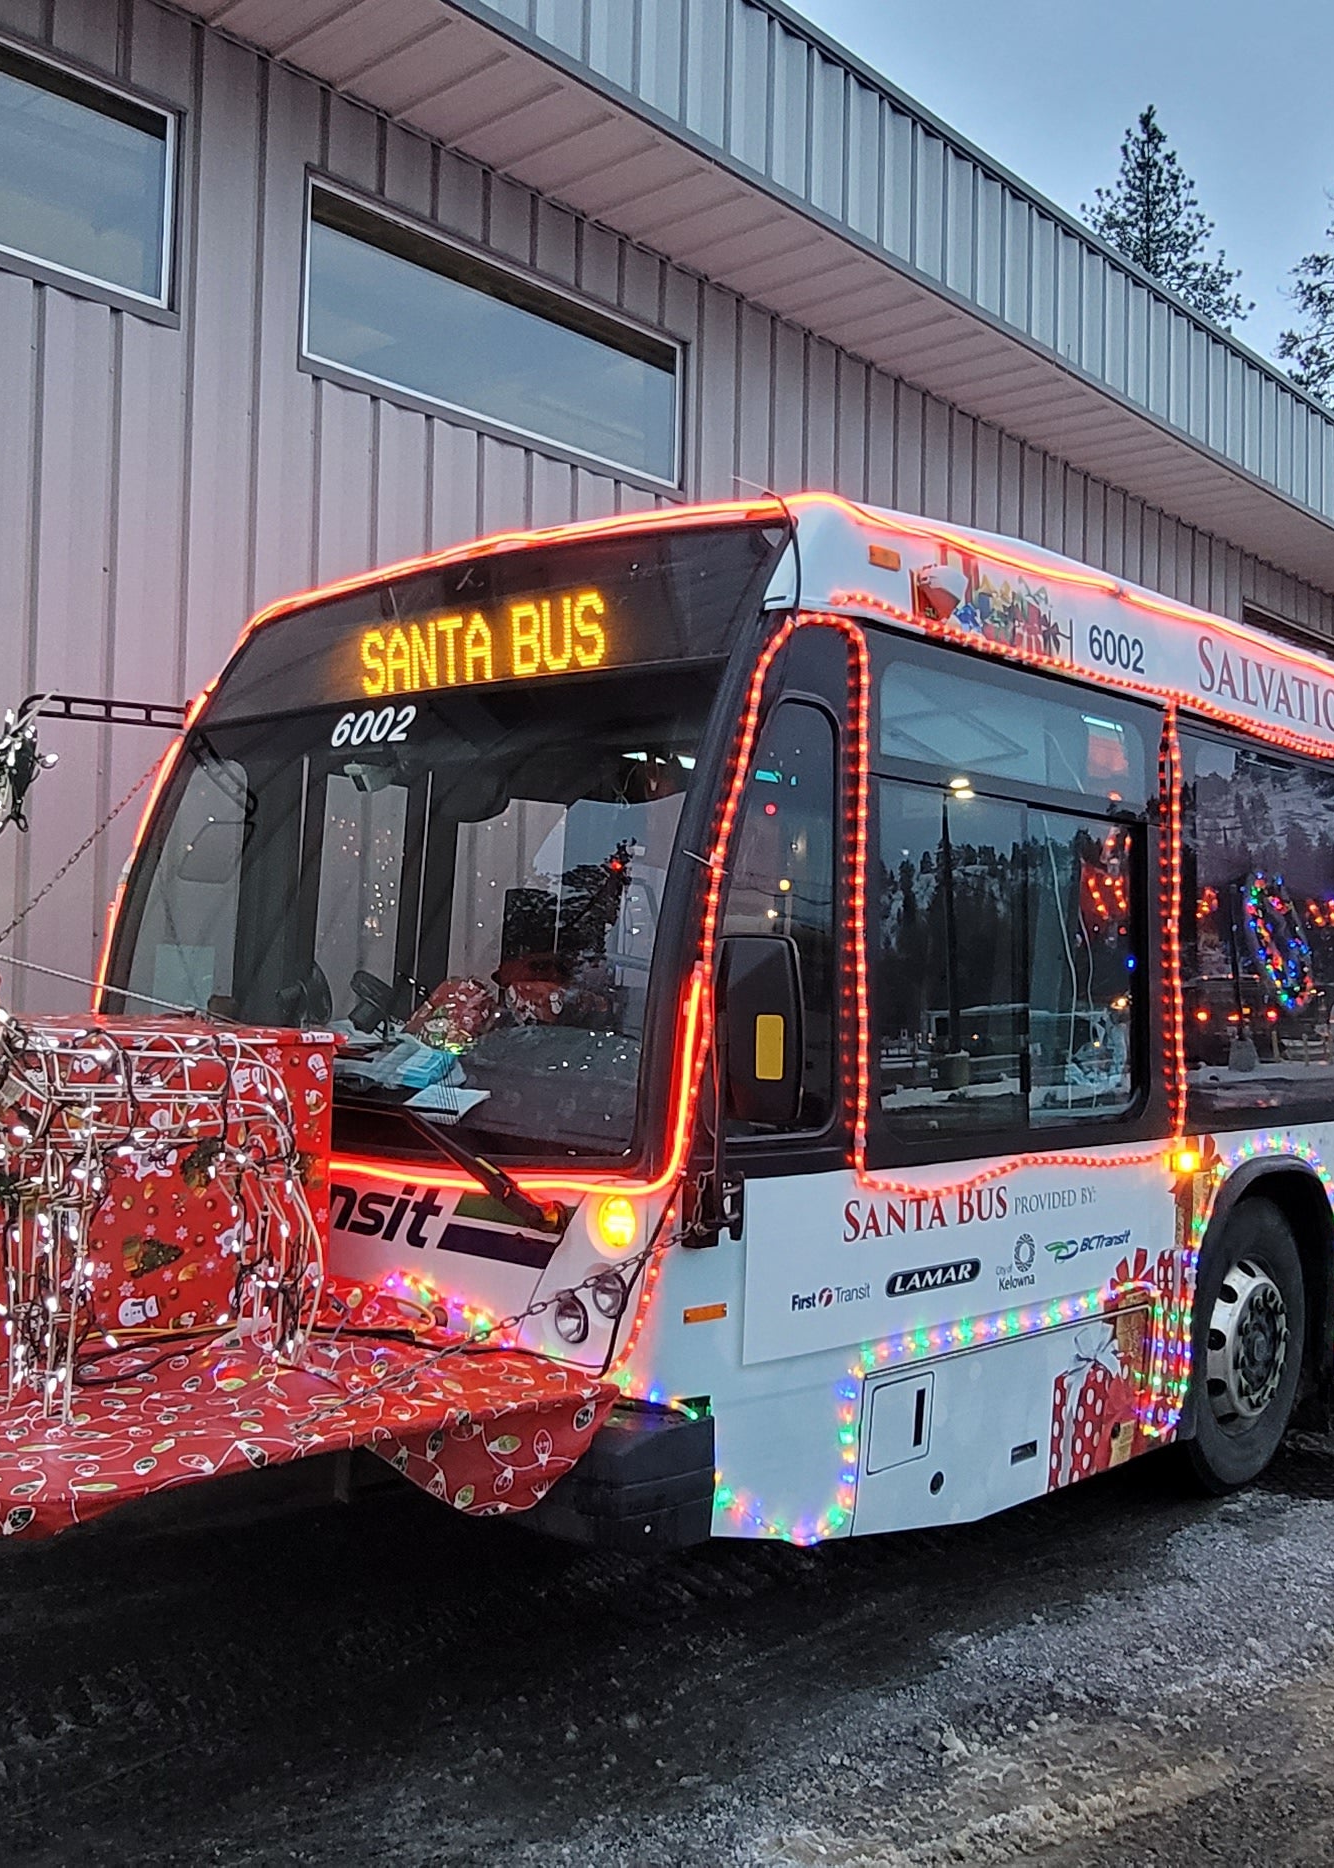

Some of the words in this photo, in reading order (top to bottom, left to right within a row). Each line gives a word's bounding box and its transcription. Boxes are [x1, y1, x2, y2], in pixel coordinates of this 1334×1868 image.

[360, 612, 494, 695] SANTA
[510, 590, 606, 677] BUS
[1088, 624, 1145, 674] 6002
[330, 705, 417, 748] 6002
[842, 1196, 948, 1243] SANTA
[956, 1185, 1008, 1226] BUS
[1014, 1189, 1077, 1216] PROVIDED
[1080, 1187, 1097, 1207] BY:
[791, 1292, 816, 1311] First
[834, 1283, 871, 1304] Transit
[894, 1263, 974, 1293] LAMAR
[998, 1273, 1036, 1291] Kelowna
